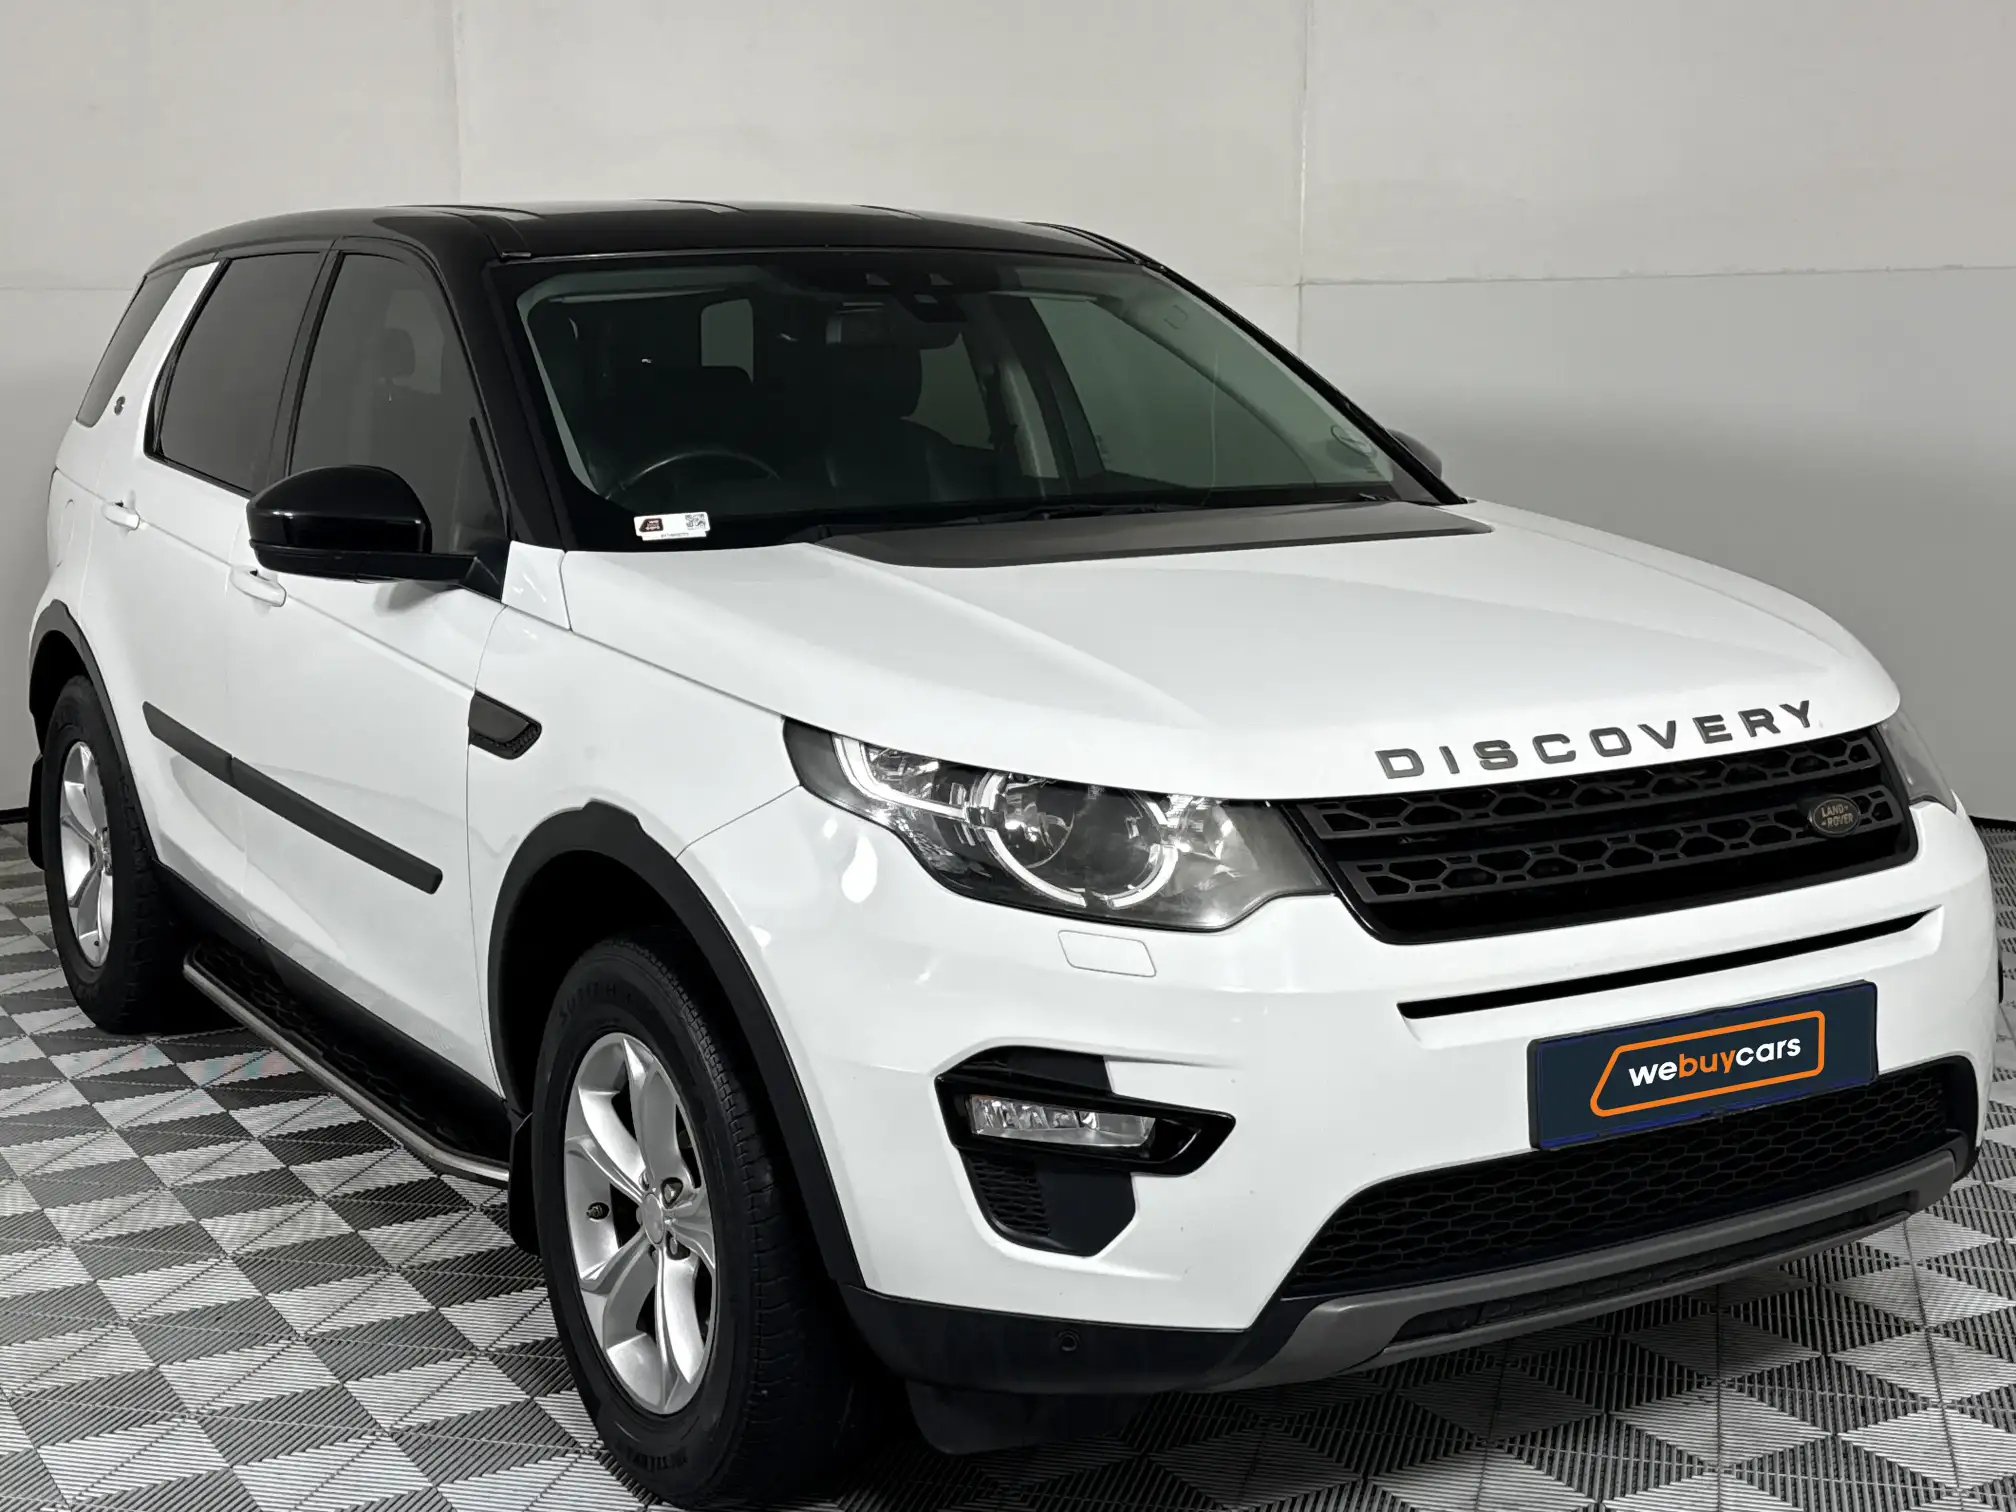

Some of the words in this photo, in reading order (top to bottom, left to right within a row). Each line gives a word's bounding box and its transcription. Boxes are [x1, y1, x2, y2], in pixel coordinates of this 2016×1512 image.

[1375, 699, 1814, 779] DISCOVERY
[1821, 804, 1843, 817] LAND
[1628, 1037, 1801, 1087] webuycars
